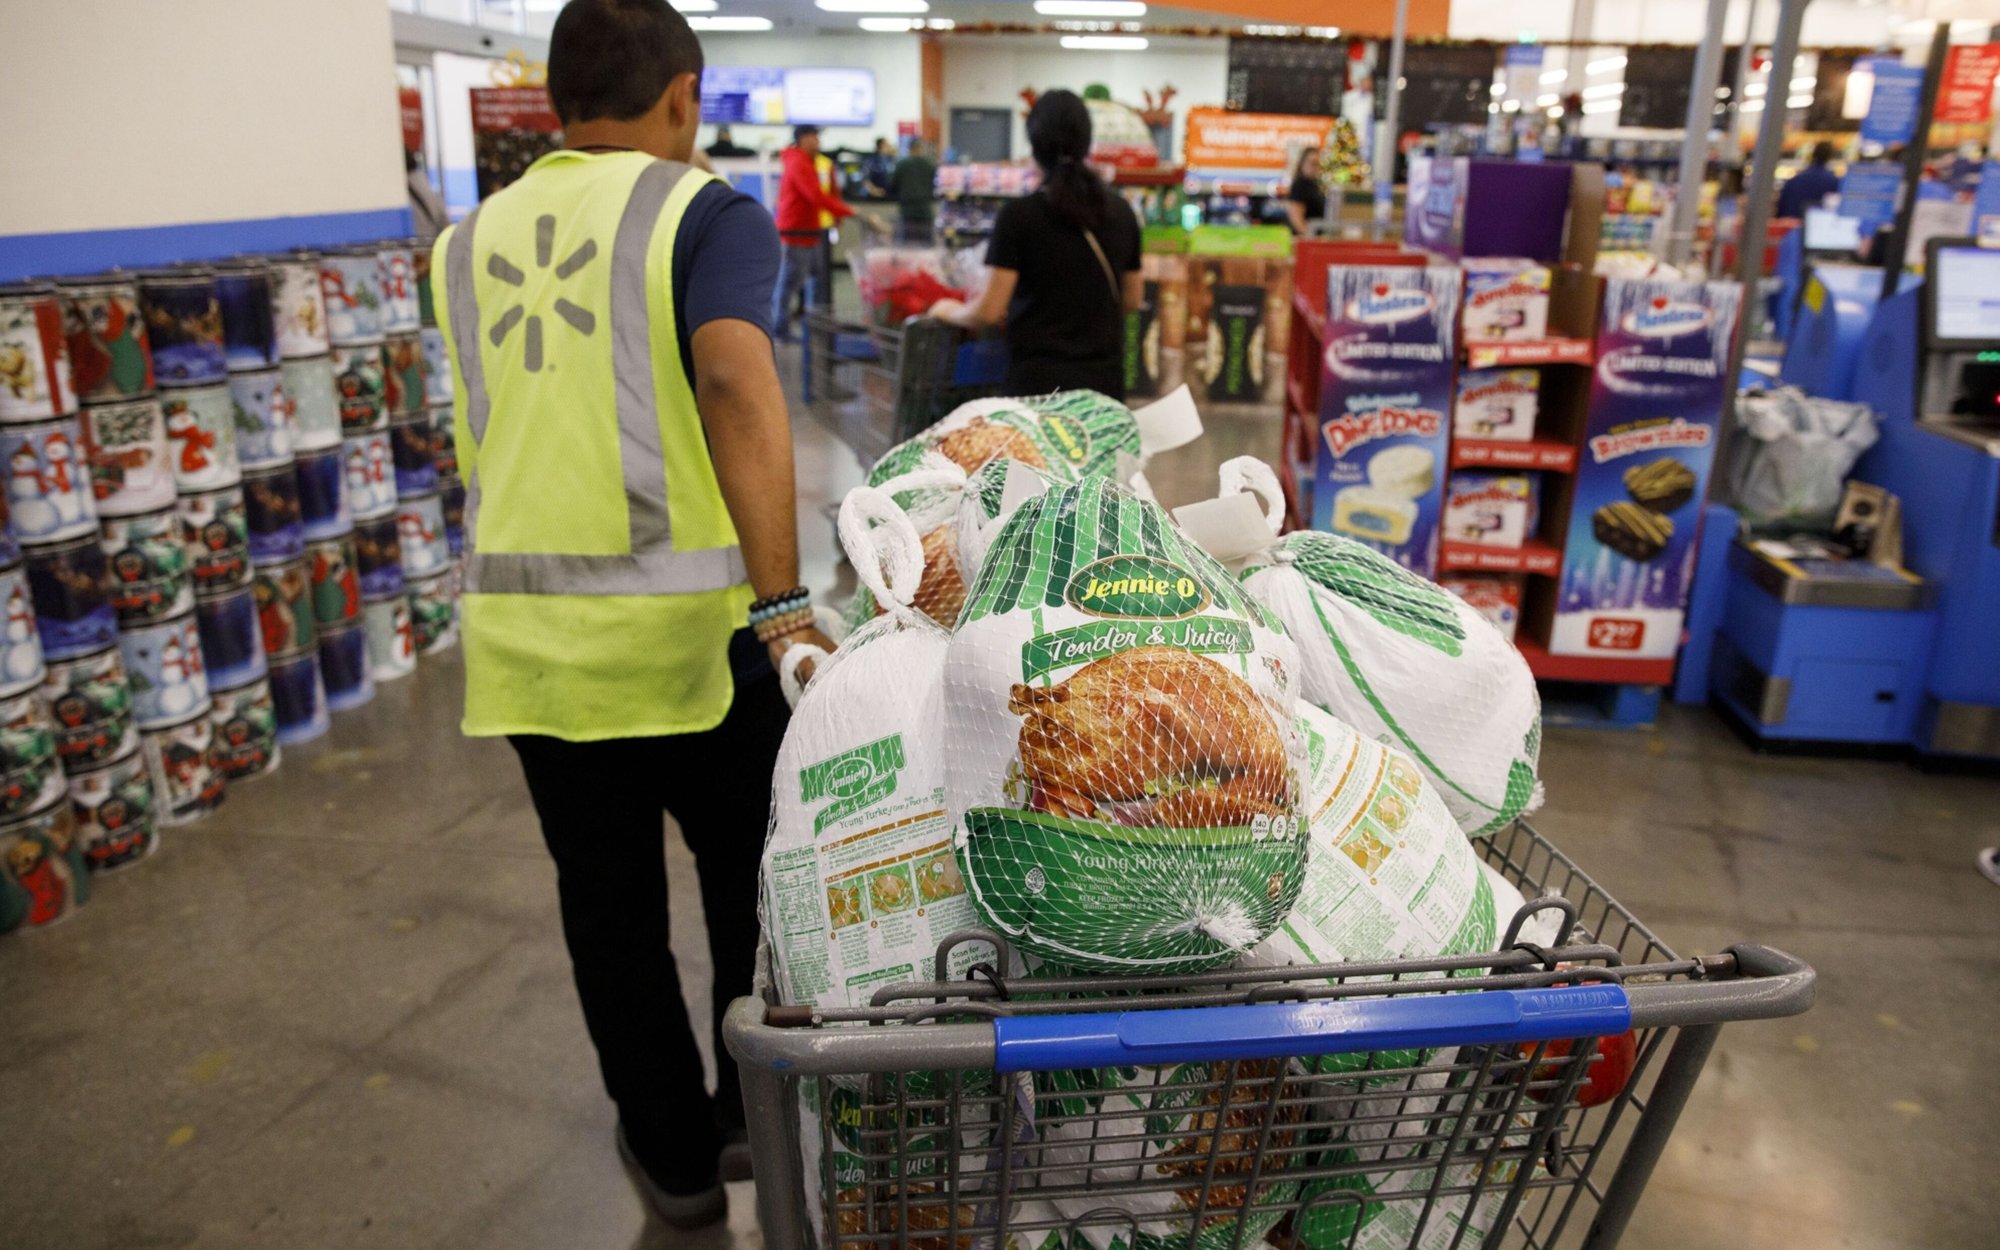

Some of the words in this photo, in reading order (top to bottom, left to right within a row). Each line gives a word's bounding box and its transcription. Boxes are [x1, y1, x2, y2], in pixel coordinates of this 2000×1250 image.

[1391, 342, 1444, 363] EDITION
[1663, 356, 1718, 379] EDITION
[1044, 627, 1138, 662] Tender
[1145, 626, 1166, 645] &
[1172, 623, 1238, 654] Juicy
[860, 784, 888, 807] Juicy
[839, 812, 864, 830] Young
[864, 803, 894, 822] Turkey
[1072, 850, 1128, 873] Young
[952, 950, 969, 959] Scan
